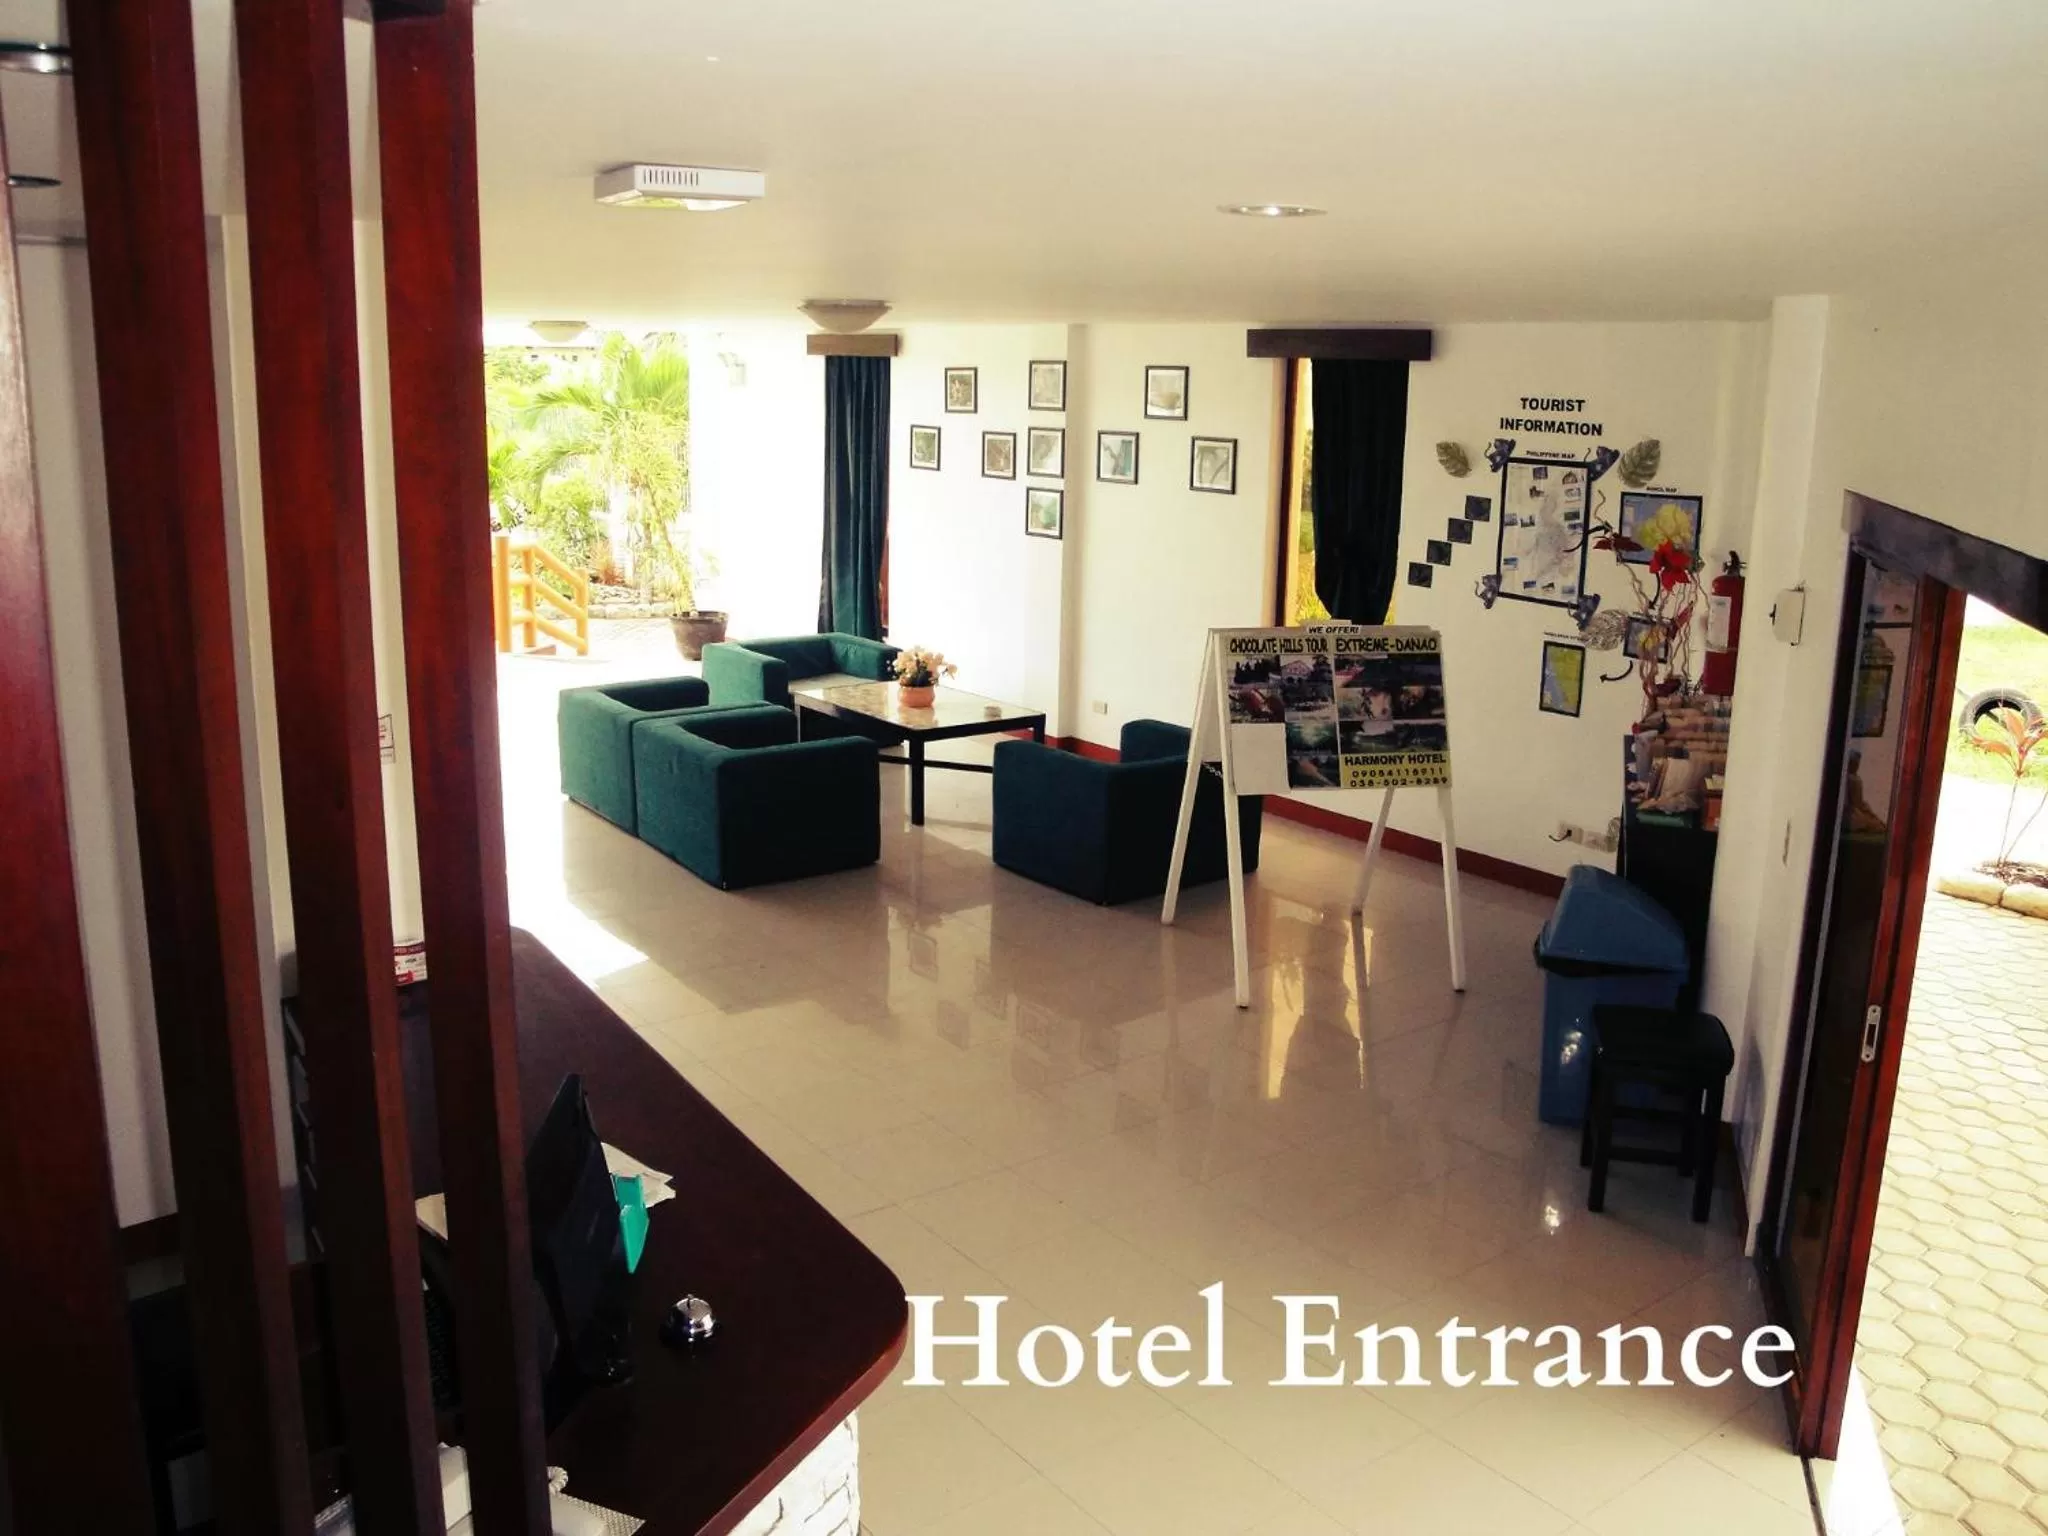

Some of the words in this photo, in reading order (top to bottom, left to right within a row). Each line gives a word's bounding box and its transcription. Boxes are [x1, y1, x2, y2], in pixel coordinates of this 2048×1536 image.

[1520, 397, 1586, 413] TOURIST
[1500, 417, 1604, 436] INFORMATION
[1308, 626, 1325, 635] WE
[1326, 626, 1360, 635] OFFER!
[1230, 638, 1277, 654] CHOCOLATE
[1279, 638, 1304, 653] HILLS
[1306, 638, 1329, 653] TOUR
[1345, 754, 1405, 767] HARMONY
[1408, 753, 1447, 766] HOTEL
